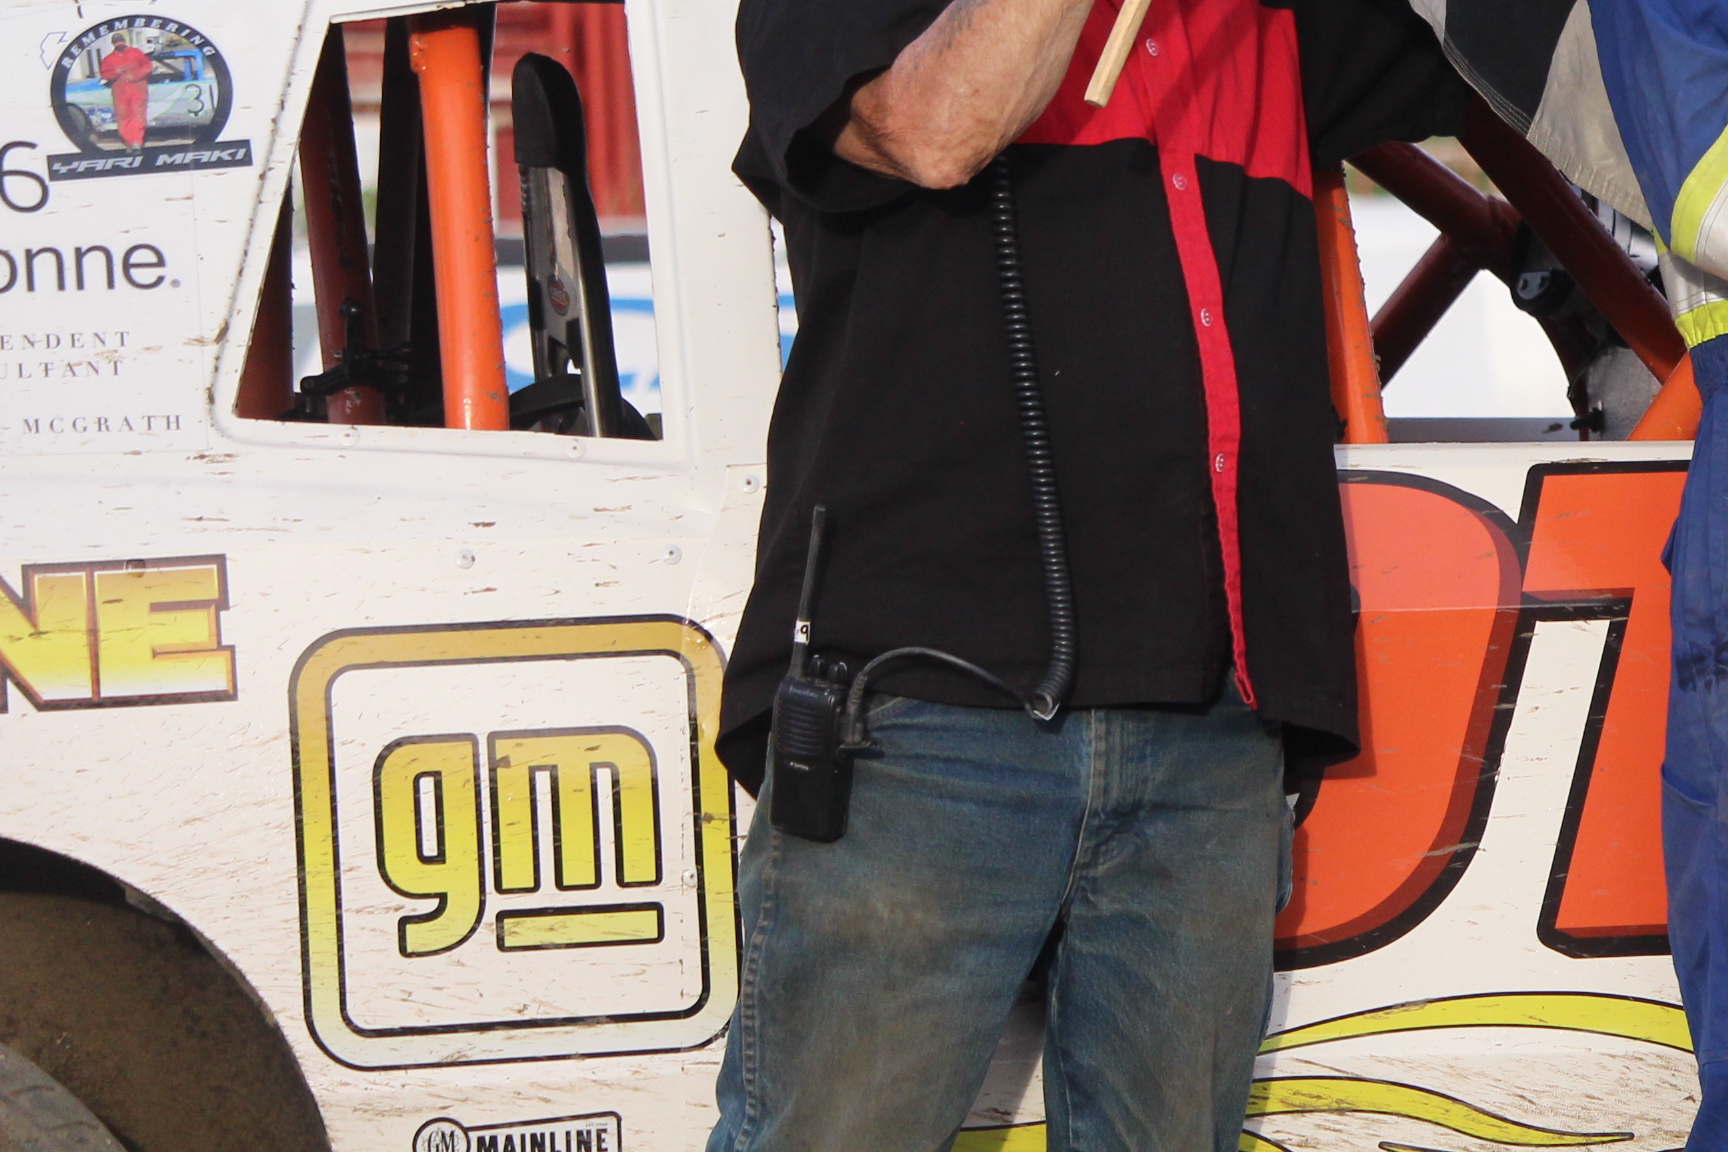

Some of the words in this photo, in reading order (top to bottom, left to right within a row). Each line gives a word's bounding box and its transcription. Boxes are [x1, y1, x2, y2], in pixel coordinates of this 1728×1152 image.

[61, 17, 216, 69] REMEMBERING
[0, 140, 49, 213] 6
[52, 155, 144, 175] YARI
[155, 148, 248, 168] MAKI
[22, 414, 182, 435] MCGRATH
[372, 724, 664, 958] gm
[476, 1128, 608, 1152] MAINLINE
